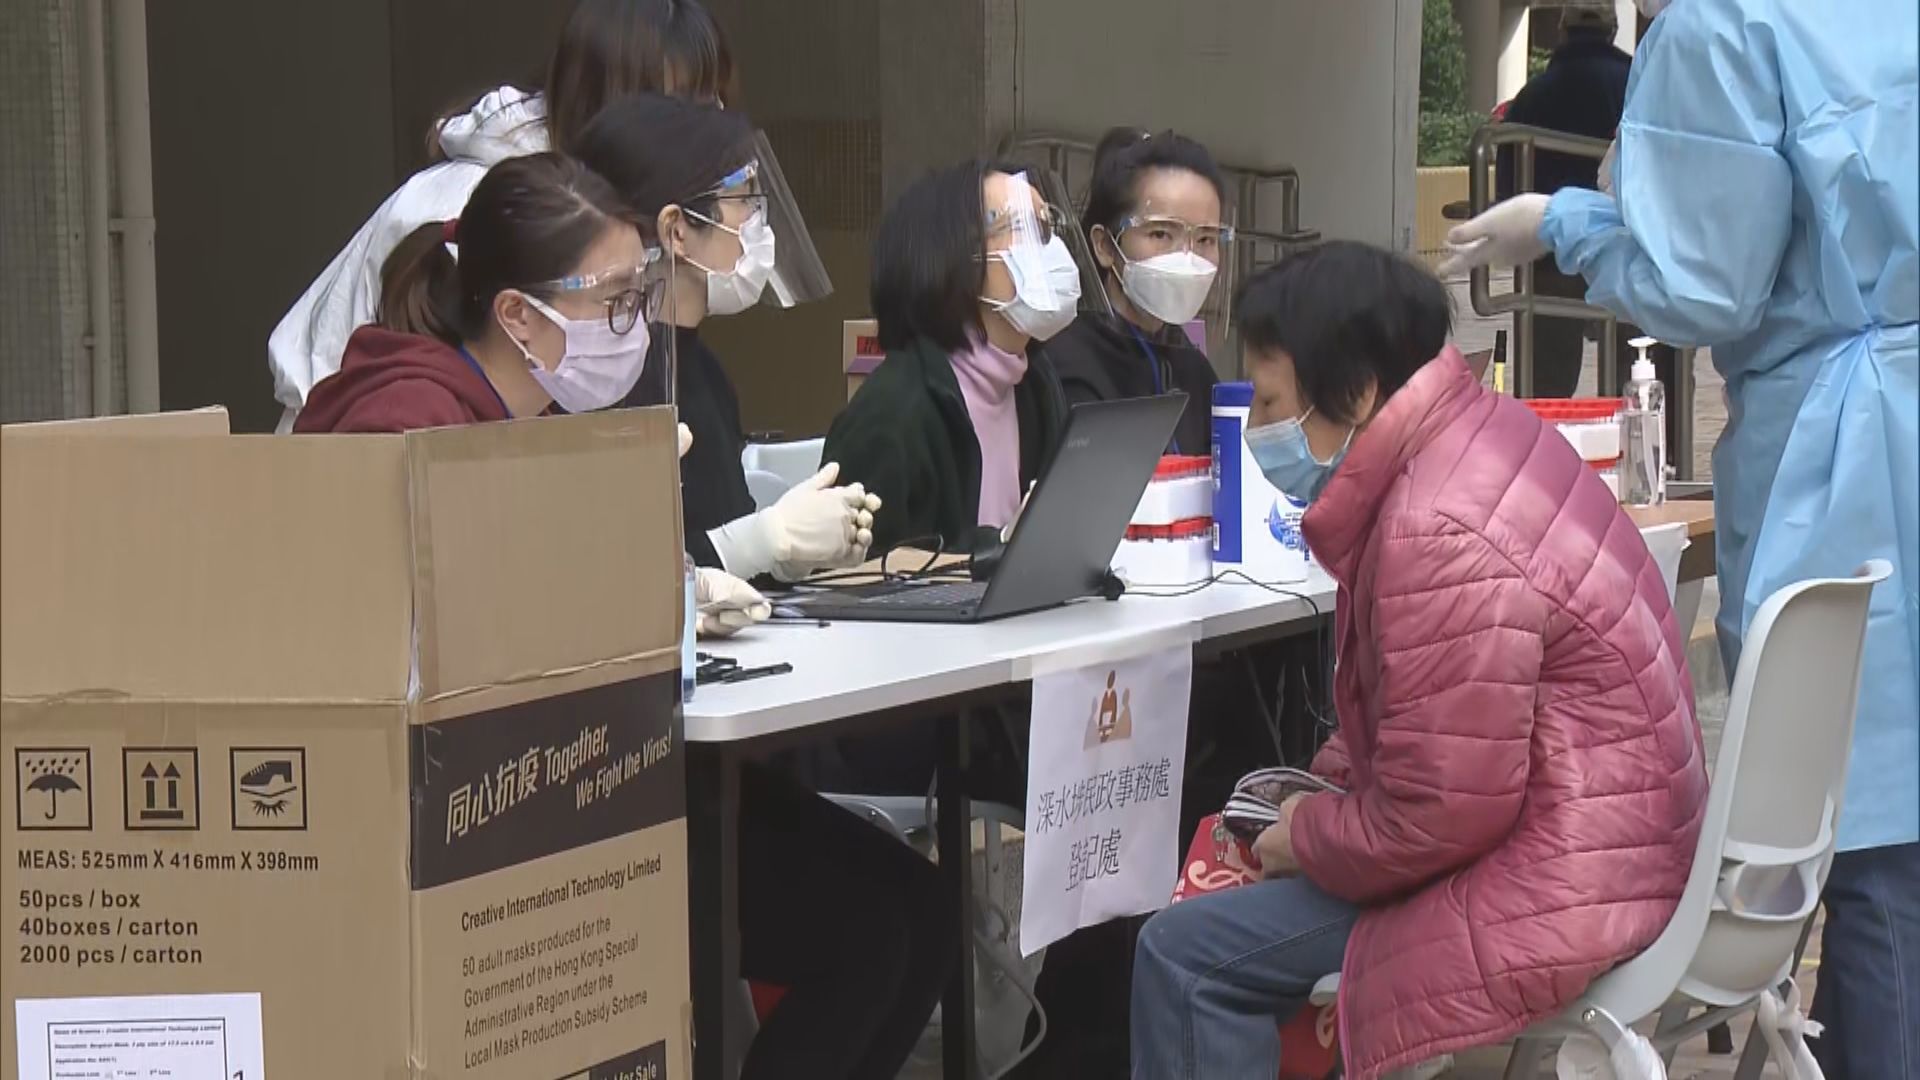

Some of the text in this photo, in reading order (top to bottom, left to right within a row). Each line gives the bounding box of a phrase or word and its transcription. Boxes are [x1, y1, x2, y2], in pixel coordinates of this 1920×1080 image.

[446, 723, 609, 845] 同心抗疫 Together,
[576, 727, 672, 811] We Fight the Virus!
[18, 850, 319, 871] MEAS: 525mm X 416mm X 398mm
[1065, 828, 1121, 891] 登記處
[19, 889, 141, 911] 50pcs / box
[461, 853, 661, 931] Creative International Technology Limited
[19, 917, 198, 936] 40boxes / carton
[20, 945, 202, 967] 2000 pcs / carton
[478, 949, 503, 973] adult
[504, 940, 536, 965] masks
[537, 926, 581, 957] produced
[582, 922, 595, 939] for
[595, 917, 611, 935] the
[464, 933, 639, 1008] Government of the Hong Kong Special
[464, 973, 613, 1040] Administrative Region under the
[465, 990, 648, 1069] Local Mask Production Subsidy Scheme
[635, 1060, 657, 1080] Sale
